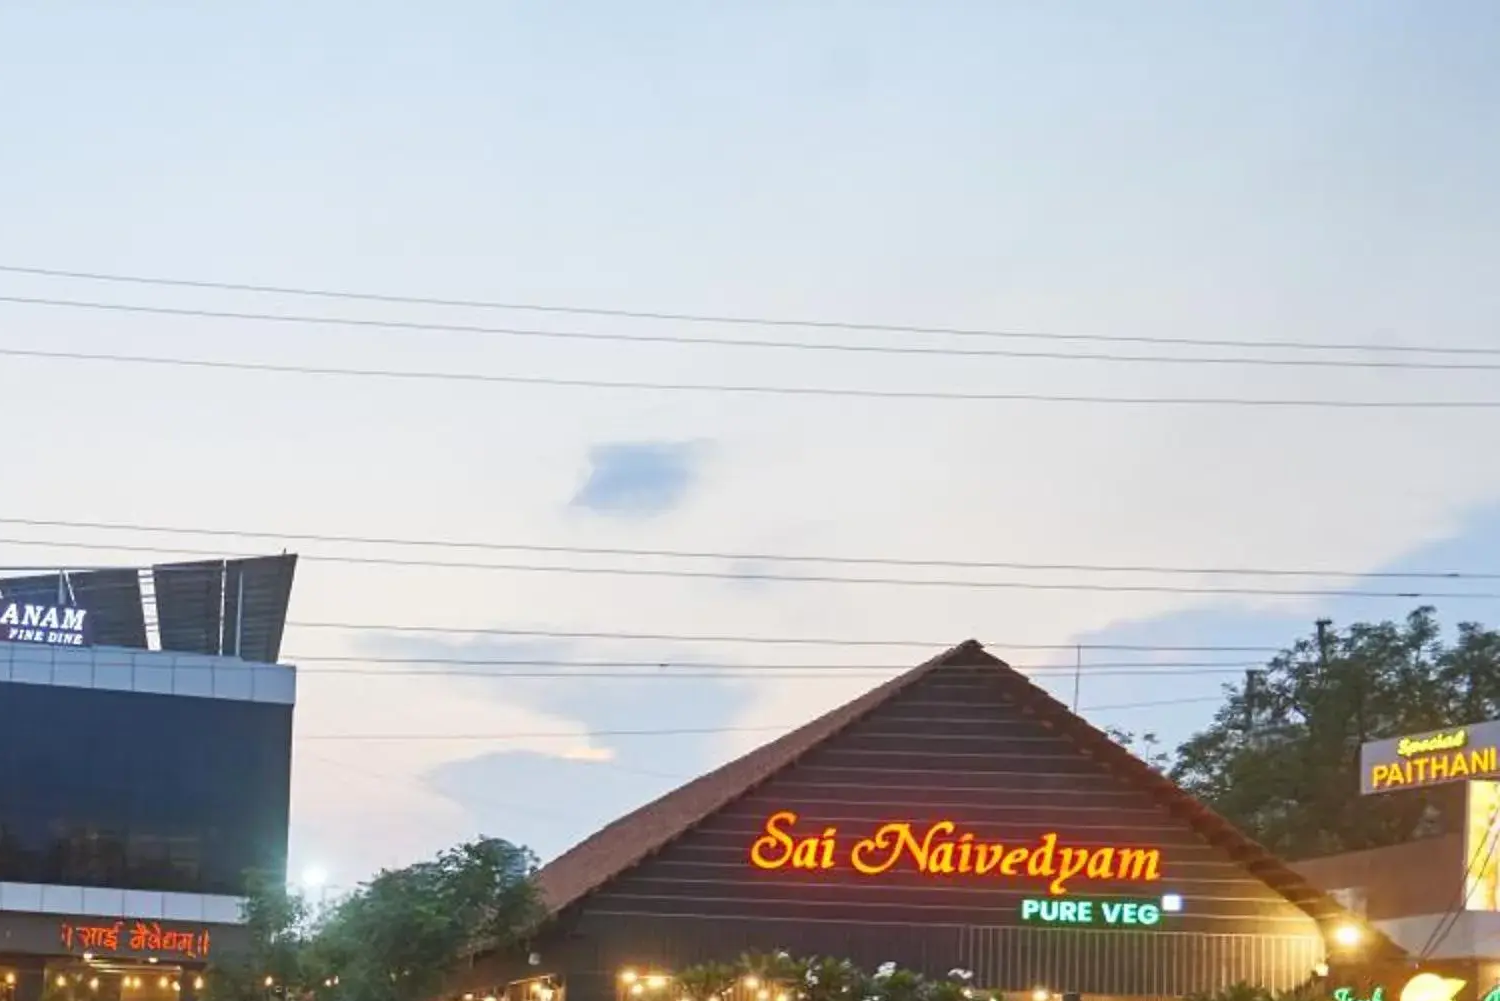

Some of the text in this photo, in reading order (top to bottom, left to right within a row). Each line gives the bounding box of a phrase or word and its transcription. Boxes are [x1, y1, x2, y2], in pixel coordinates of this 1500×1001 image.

[8, 627, 85, 647] FINE DINE
[1371, 746, 1499, 789] PAITHANI
[750, 810, 1162, 895] Sai Naivedyam
[1021, 898, 1160, 925] PURE VEG
